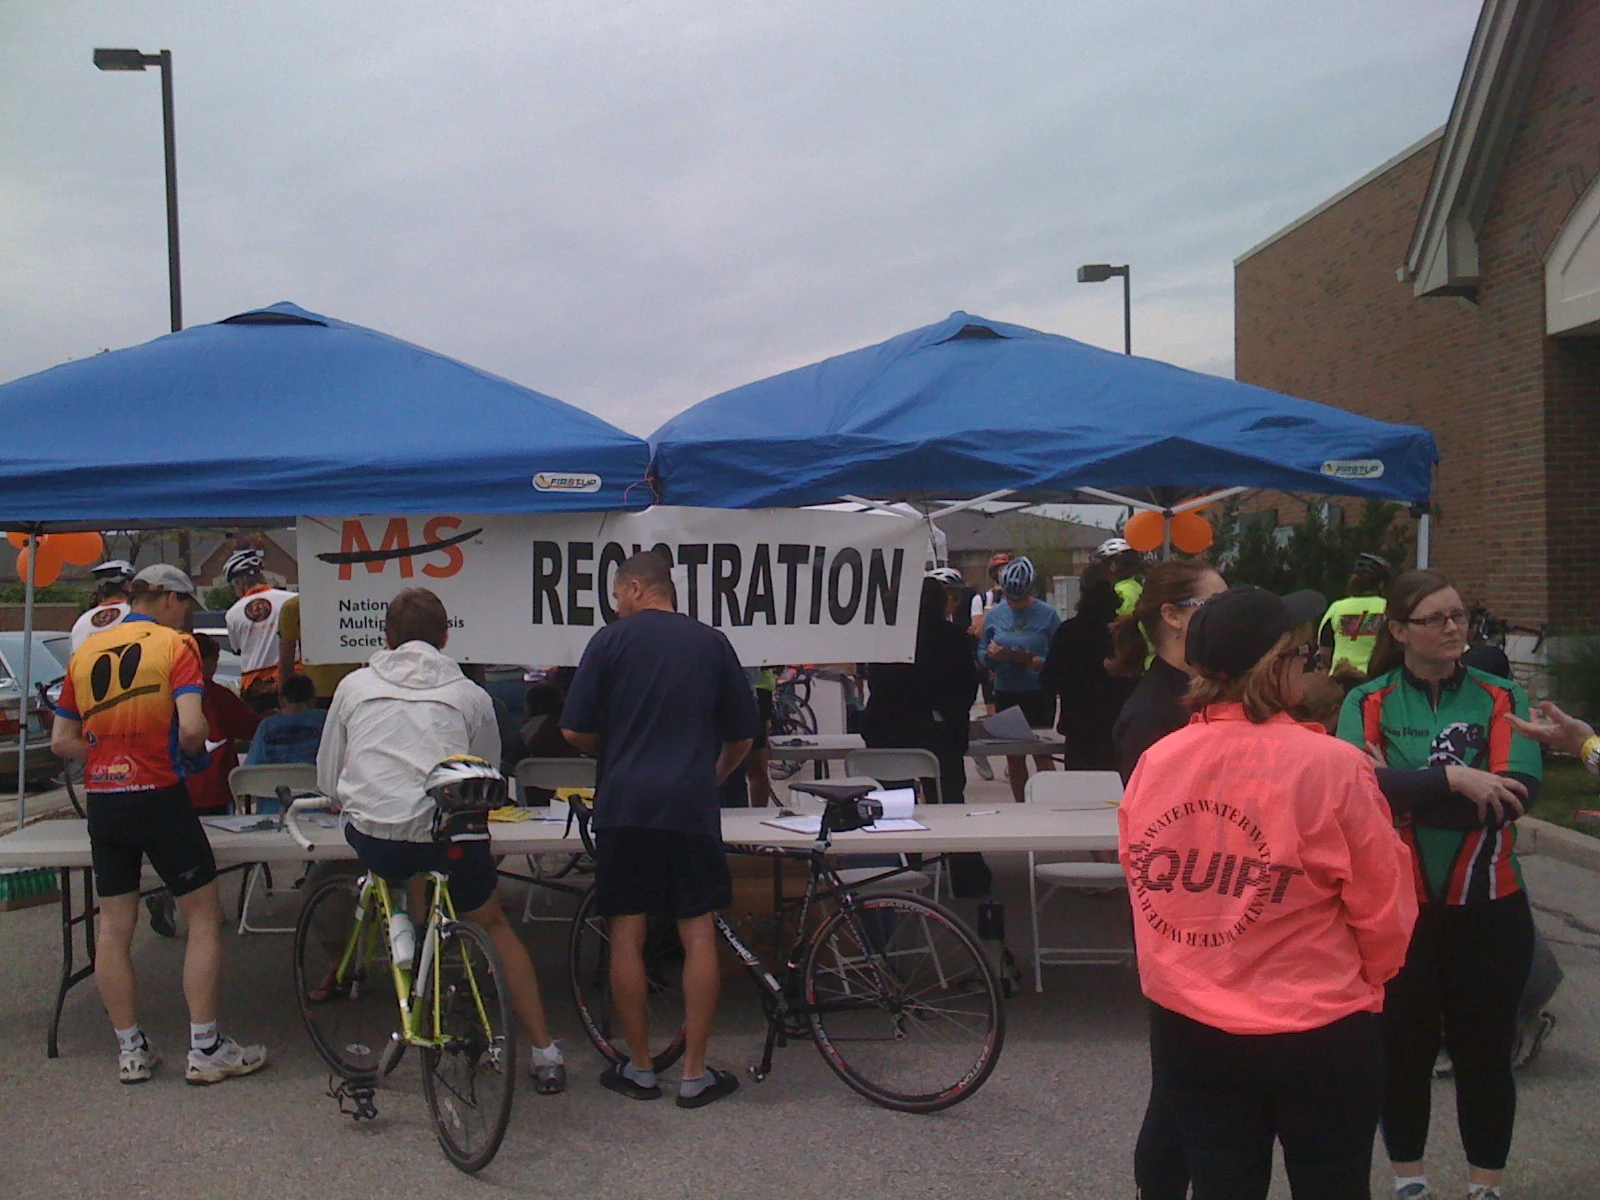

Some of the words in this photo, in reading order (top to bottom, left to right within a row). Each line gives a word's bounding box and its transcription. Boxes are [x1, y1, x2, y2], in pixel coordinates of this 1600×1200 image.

[338, 516, 464, 580] MS
[531, 540, 905, 628] RETRATION
[339, 599, 388, 613] Nation
[339, 614, 387, 632] Multip
[339, 634, 387, 650] Societ
[1144, 799, 1195, 840] WATER
[1198, 799, 1250, 832] WATER
[1141, 899, 1184, 944] WATER
[1234, 886, 1272, 936] WATER
[958, 1043, 990, 1089] EASTON
